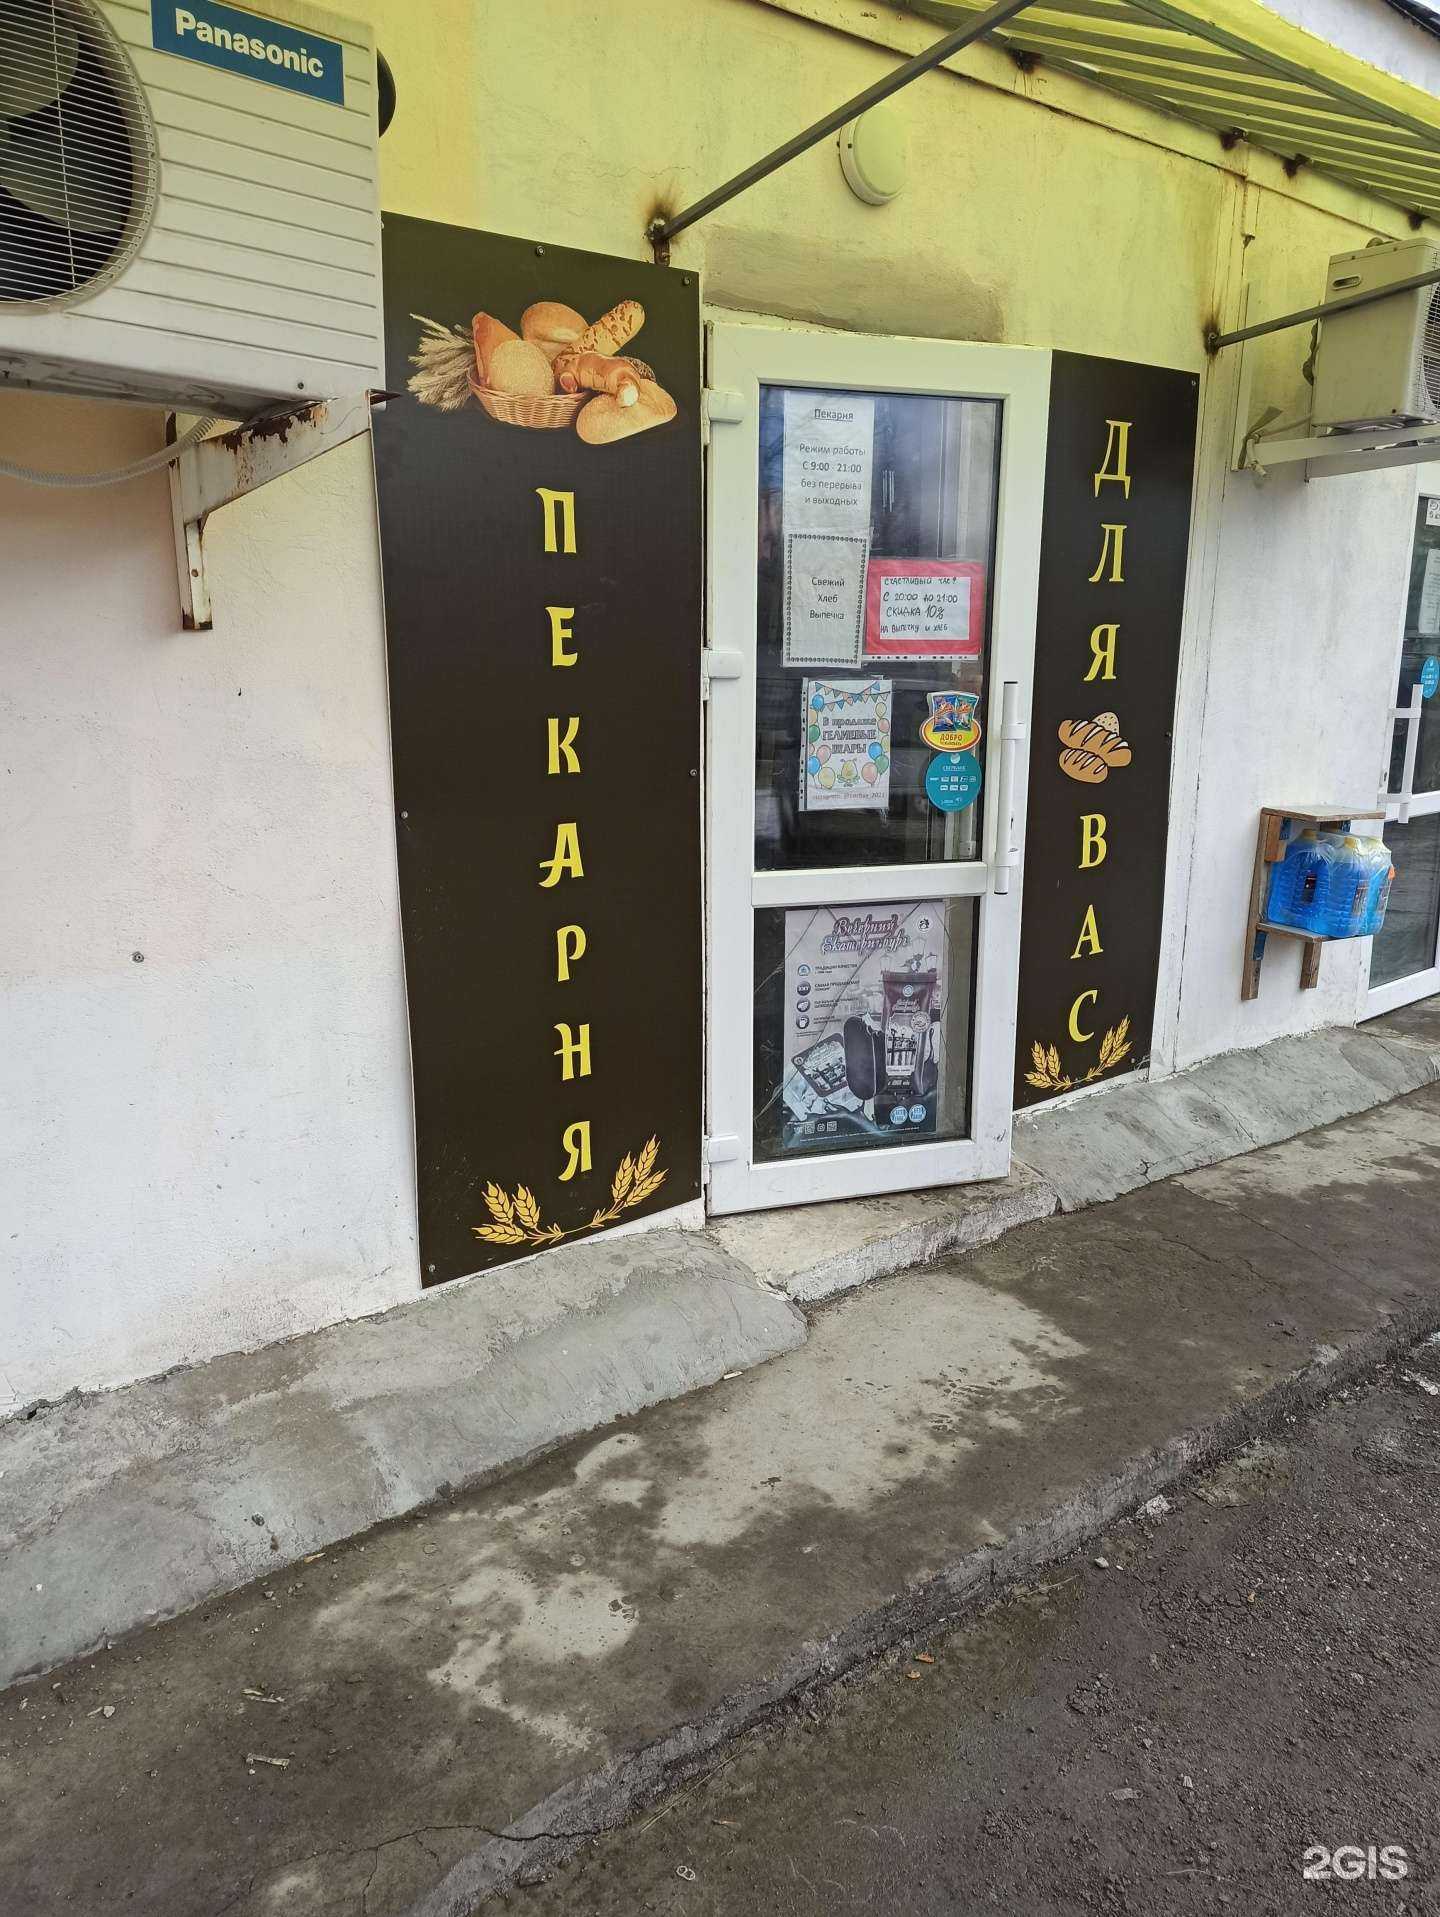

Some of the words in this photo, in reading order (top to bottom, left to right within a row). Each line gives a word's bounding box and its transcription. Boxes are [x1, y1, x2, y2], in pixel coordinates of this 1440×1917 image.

[175, 8, 324, 78] Panasonic
[814, 408, 854, 423] Пекарня
[799, 443, 831, 457] Режим
[833, 446, 866, 457] работы
[810, 461, 830, 472] 9:00
[836, 463, 862, 473] 21:00
[800, 479, 817, 489] без
[812, 497, 858, 506] выходных
[1084, 419, 1132, 682] ДЛЯ
[811, 576, 845, 587] Свежий
[817, 593, 839, 603] Хлеб
[894, 593, 919, 601] 20:00
[936, 594, 958, 603] 21:00
[809, 609, 845, 620] Выпечка
[886, 606, 921, 617] СКИДКА
[925, 605, 945, 620] 10%
[822, 729, 877, 741] ГЕЛИЕВЫЕ
[831, 743, 867, 754] ШАРЫ
[535, 487, 592, 1182] ПЕКАРНЯ
[1068, 812, 1108, 1042] ВАС
